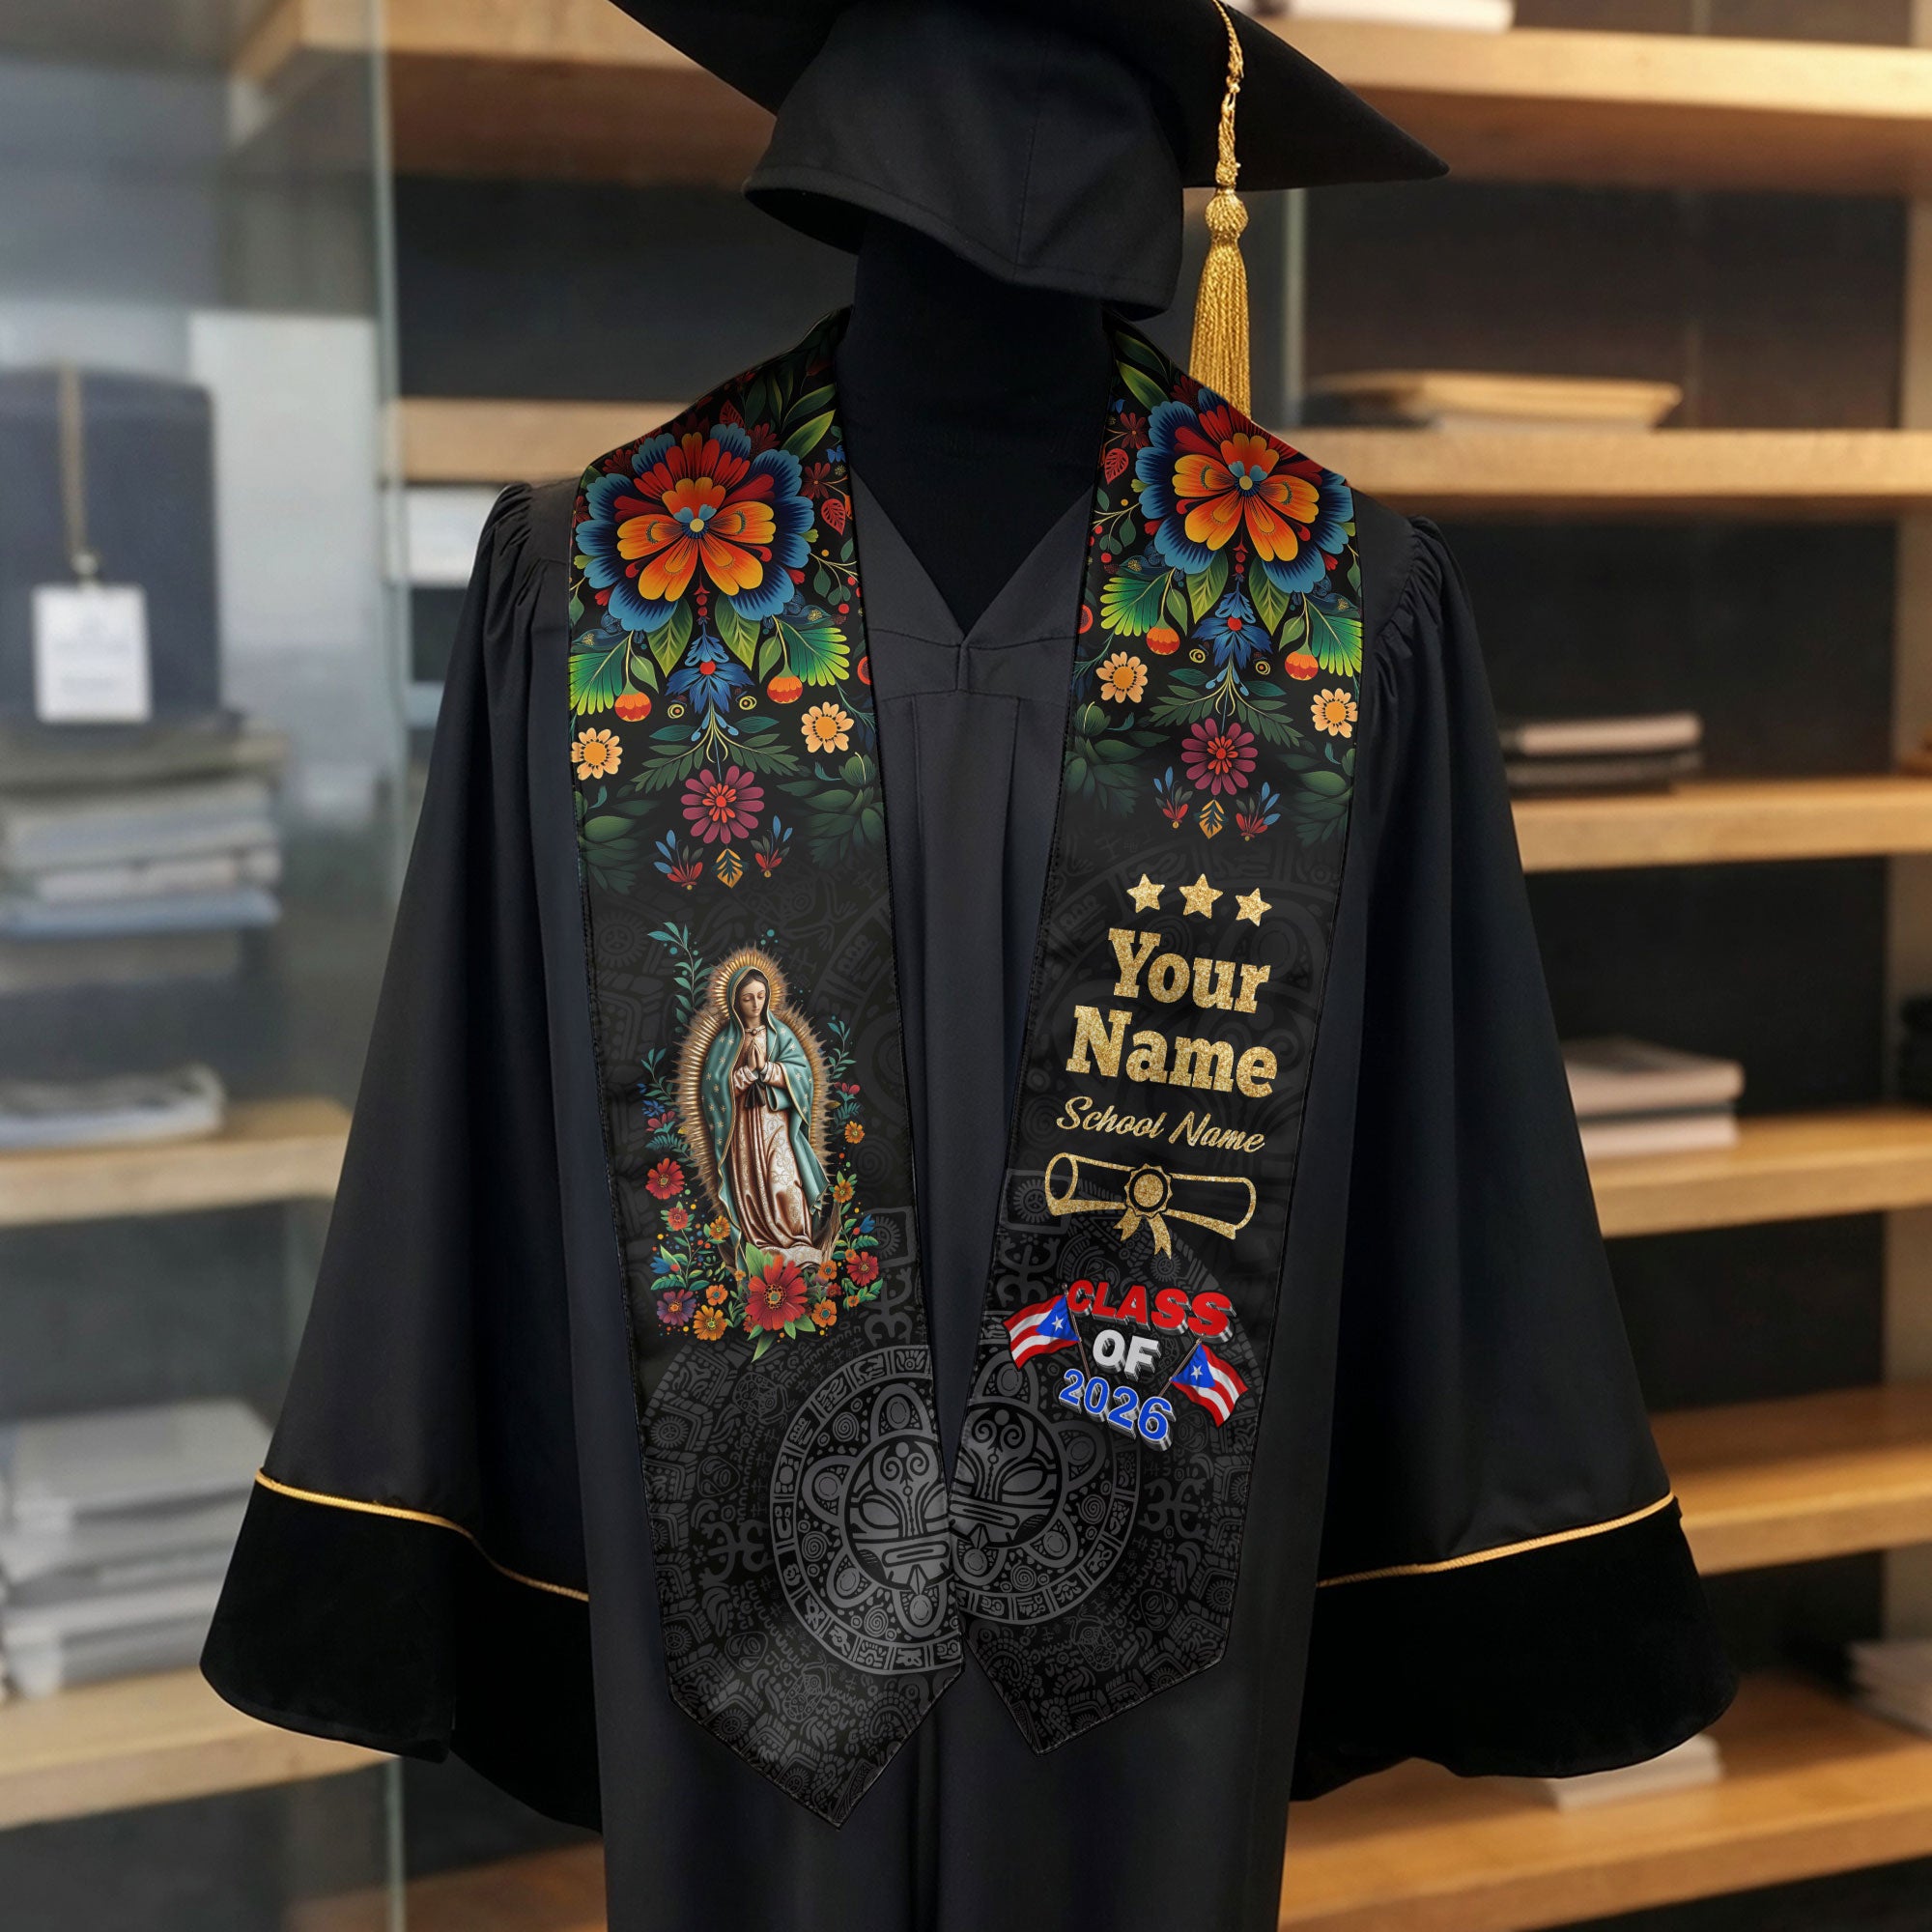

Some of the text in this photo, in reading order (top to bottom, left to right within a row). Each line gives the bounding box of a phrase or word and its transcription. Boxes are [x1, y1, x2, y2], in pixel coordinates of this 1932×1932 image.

[1108, 927, 1271, 1014] Your
[1065, 1005, 1278, 1098] Name
[1056, 1095, 1265, 1153] School Name
[1066, 1279, 1236, 1343] CLASS
[1093, 1329, 1161, 1381] OF
[1059, 1368, 1177, 1451] 2026
